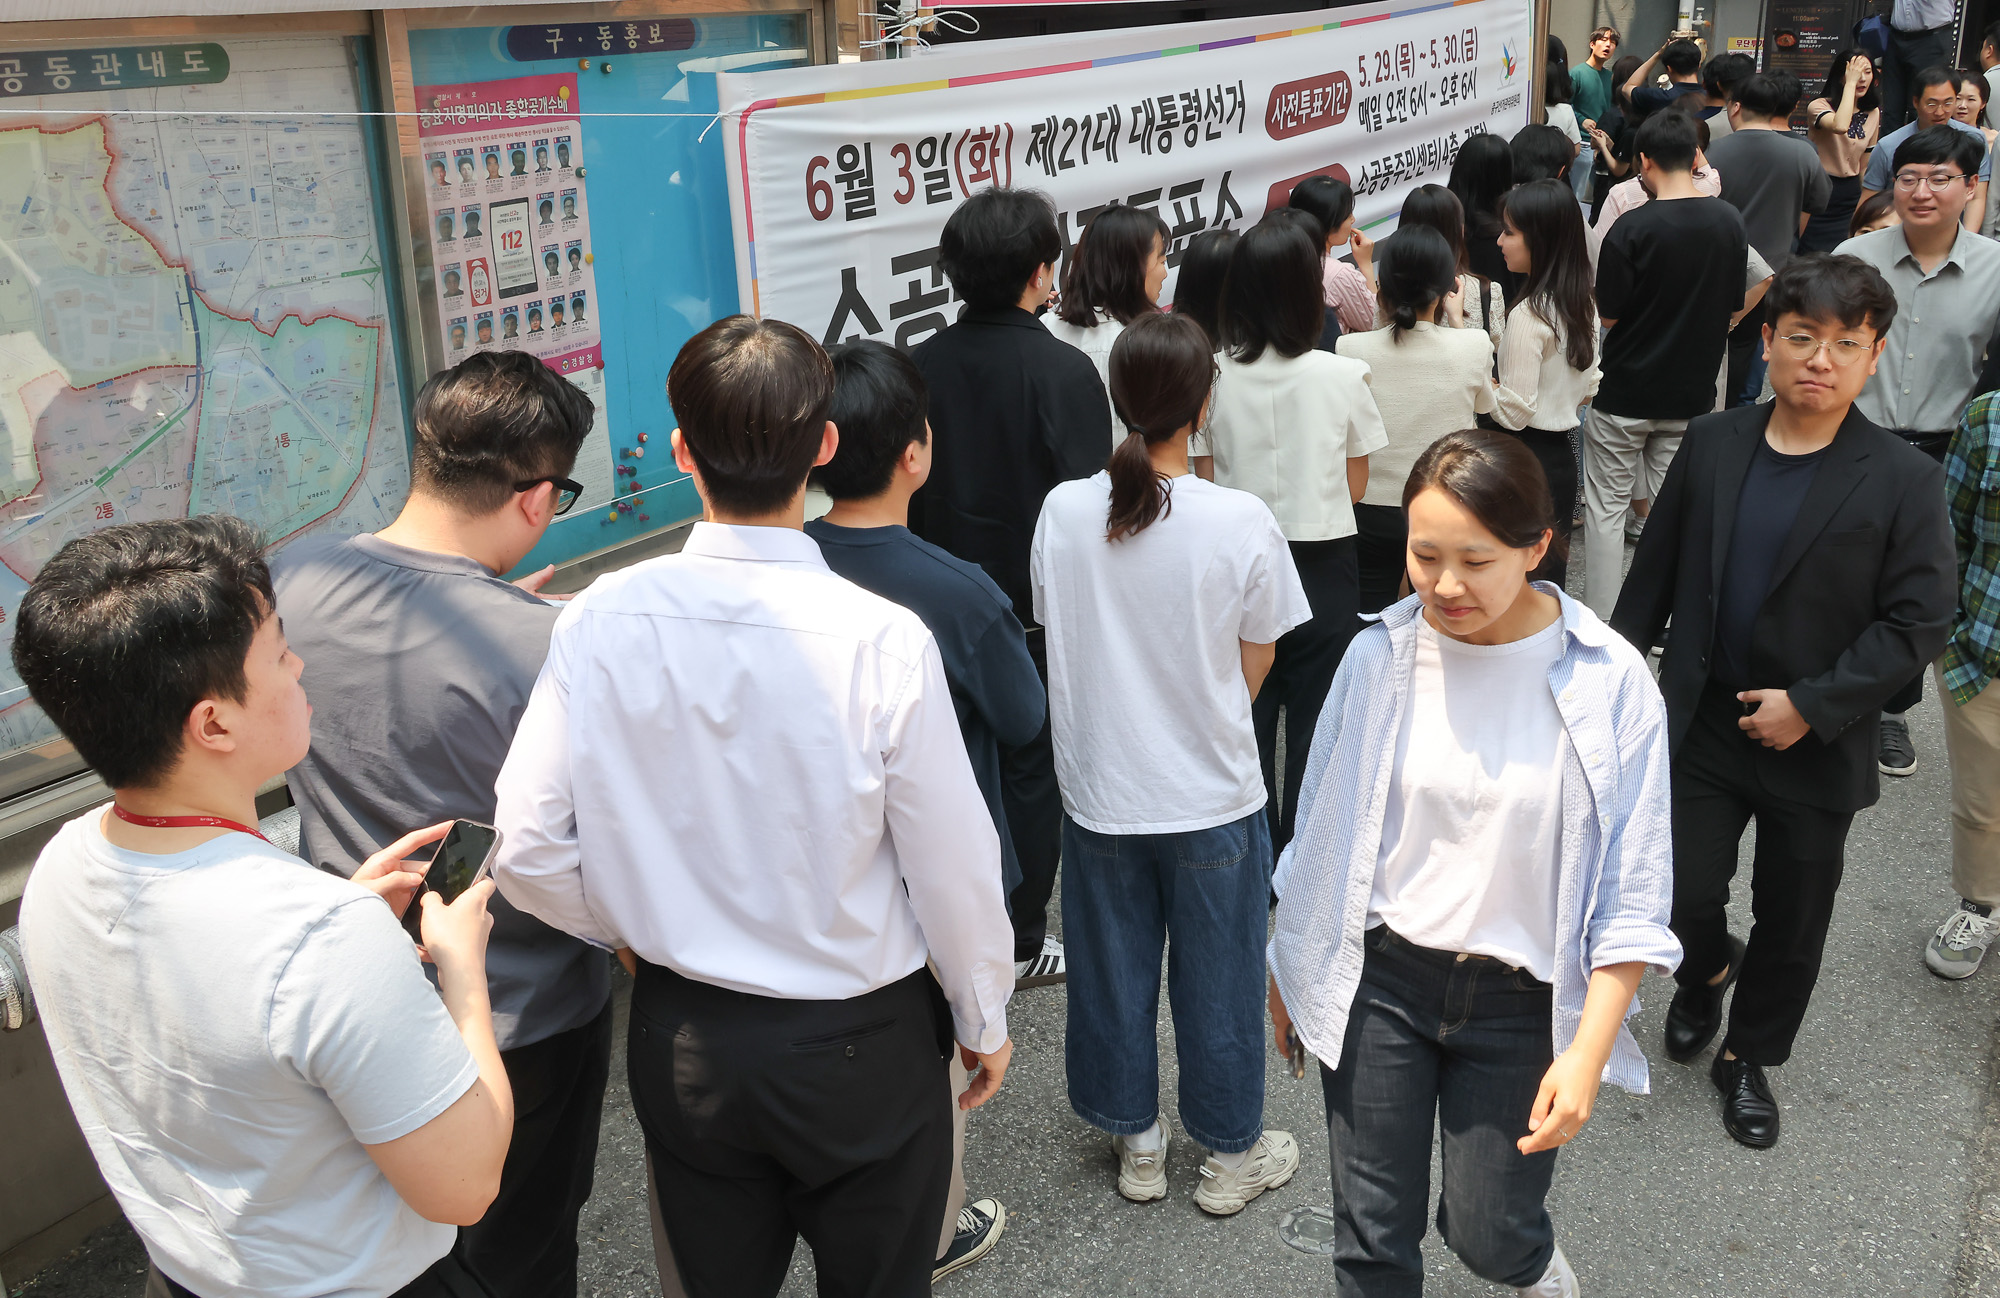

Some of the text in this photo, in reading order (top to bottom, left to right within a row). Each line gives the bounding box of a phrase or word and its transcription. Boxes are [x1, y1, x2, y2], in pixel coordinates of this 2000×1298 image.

[419, 95, 568, 129] 중요지명피의자 종합공개수배
[1271, 80, 1349, 130] 사전투표기간
[1358, 93, 1383, 133] 매일
[1386, 86, 1408, 123] 오전
[1409, 81, 1428, 117] 6시
[1440, 72, 1459, 106] 오후
[1461, 67, 1478, 101] 6시
[805, 80, 1246, 221] 6월 3일(화) 제21대 대통령선거
[501, 229, 523, 251] 112
[571, 353, 593, 368] 경찰청
[275, 432, 291, 449] 1통
[95, 501, 115, 520] 2통
